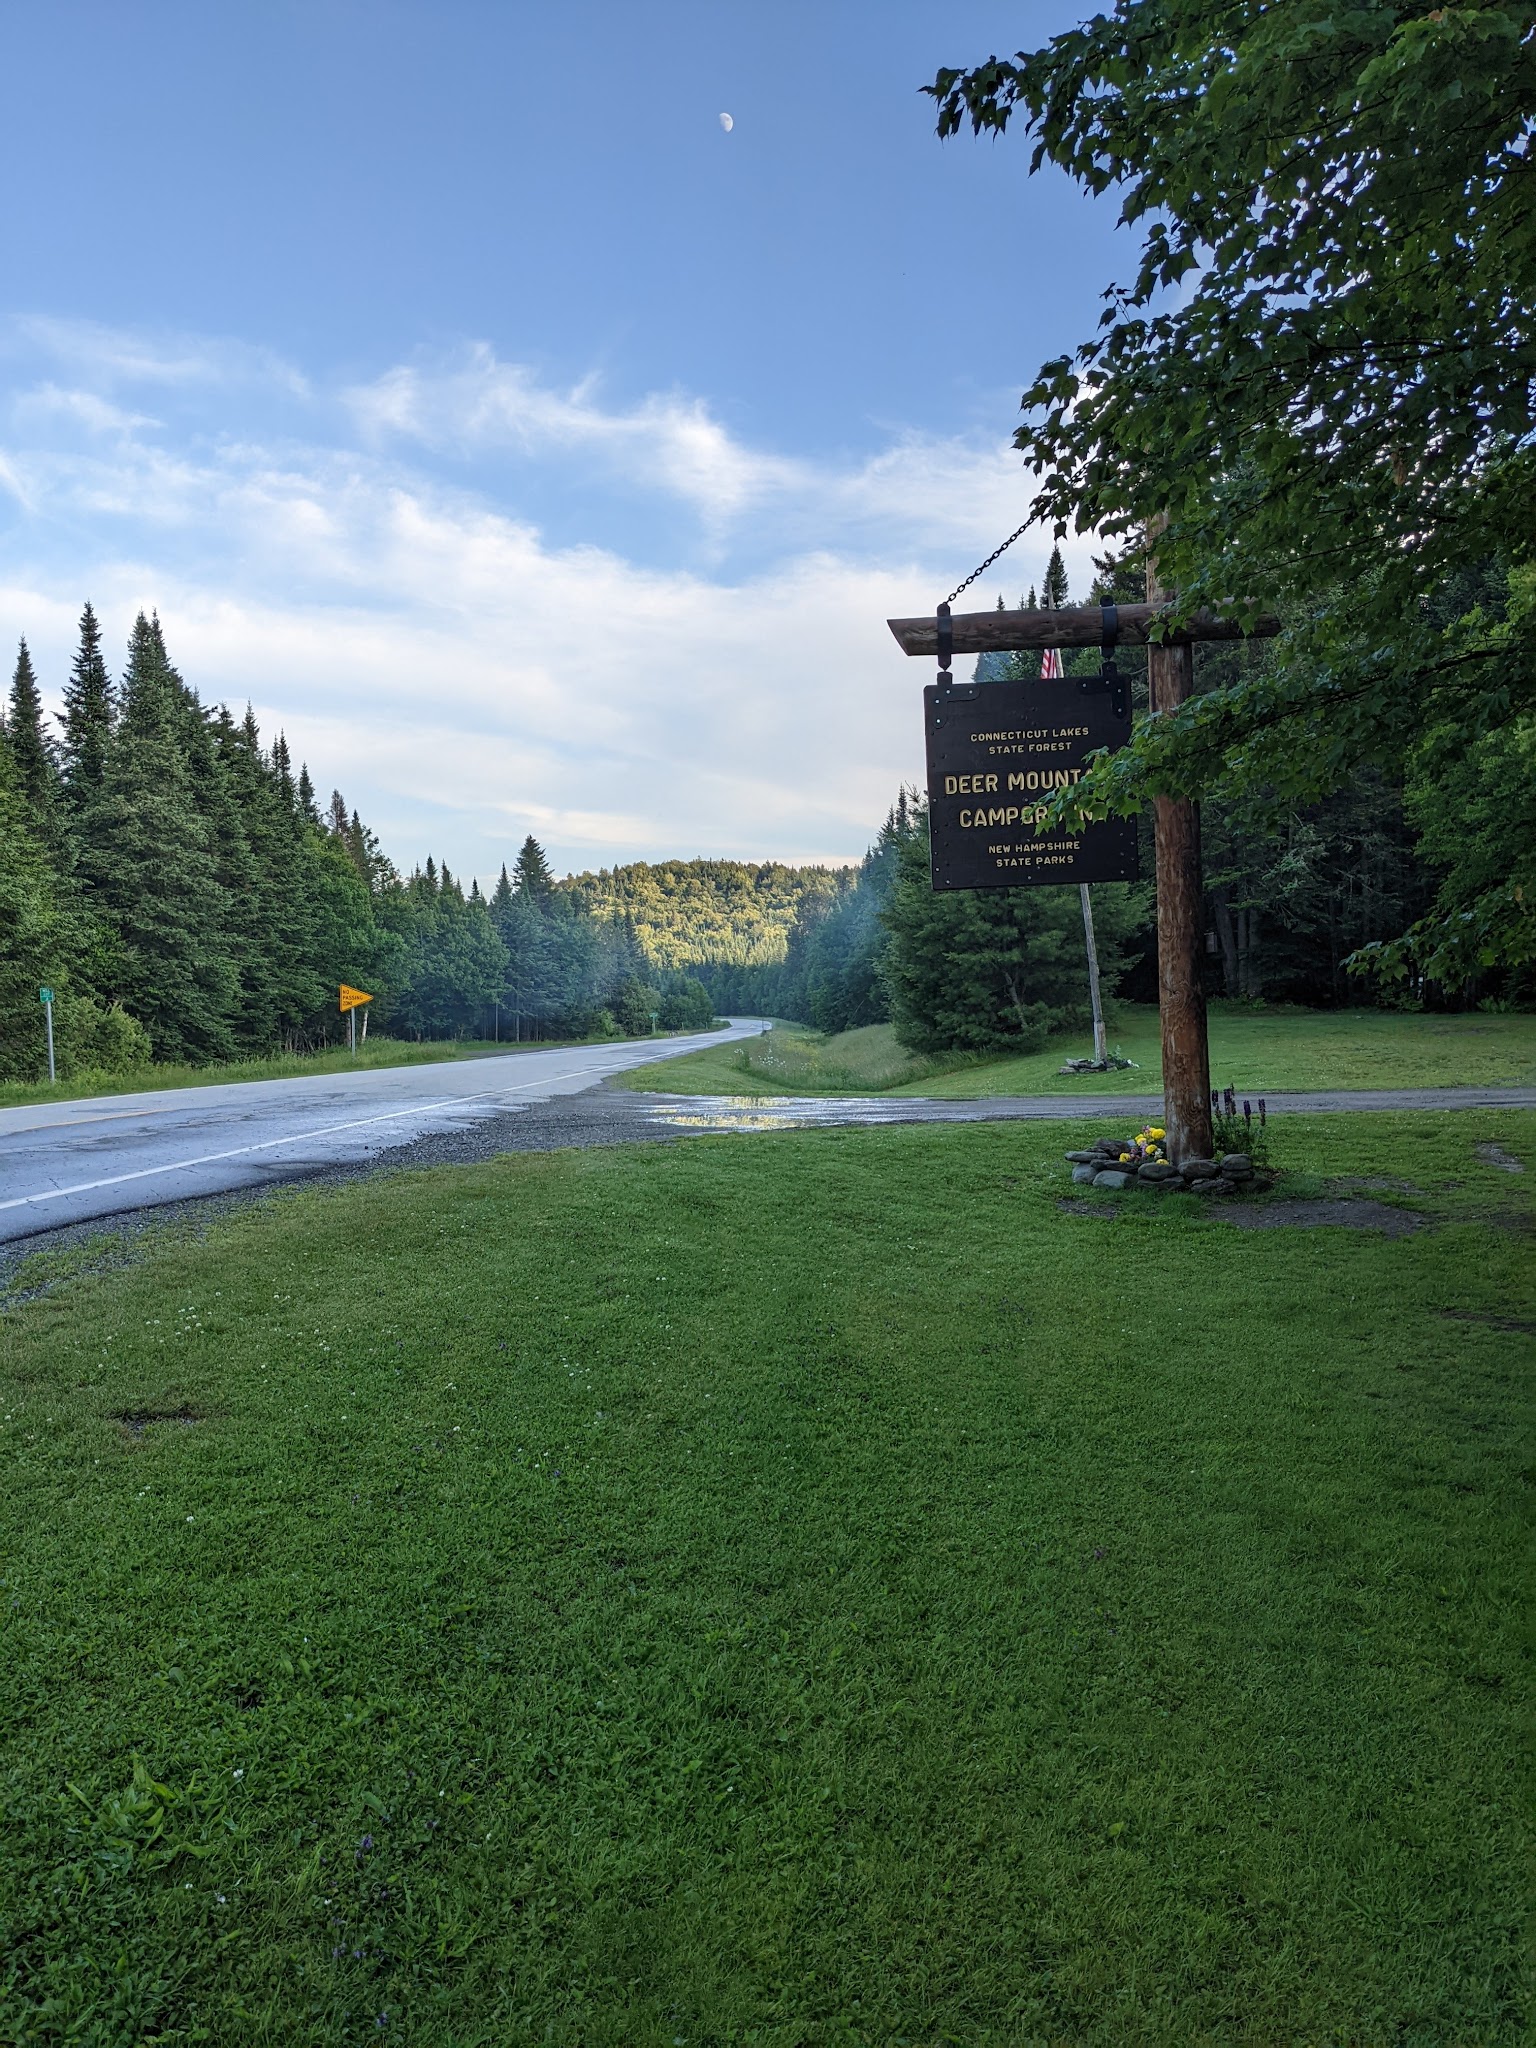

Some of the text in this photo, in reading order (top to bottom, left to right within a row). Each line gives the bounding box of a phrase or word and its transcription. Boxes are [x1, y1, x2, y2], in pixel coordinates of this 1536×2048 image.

[970, 727, 1089, 742] CONNECTICUT LAKES
[988, 742, 1072, 755] STATE FOREST
[944, 773, 998, 795] DEER
[988, 841, 1081, 854] NEW HAMPSHIRE
[996, 855, 1074, 868] STATE PARKS
